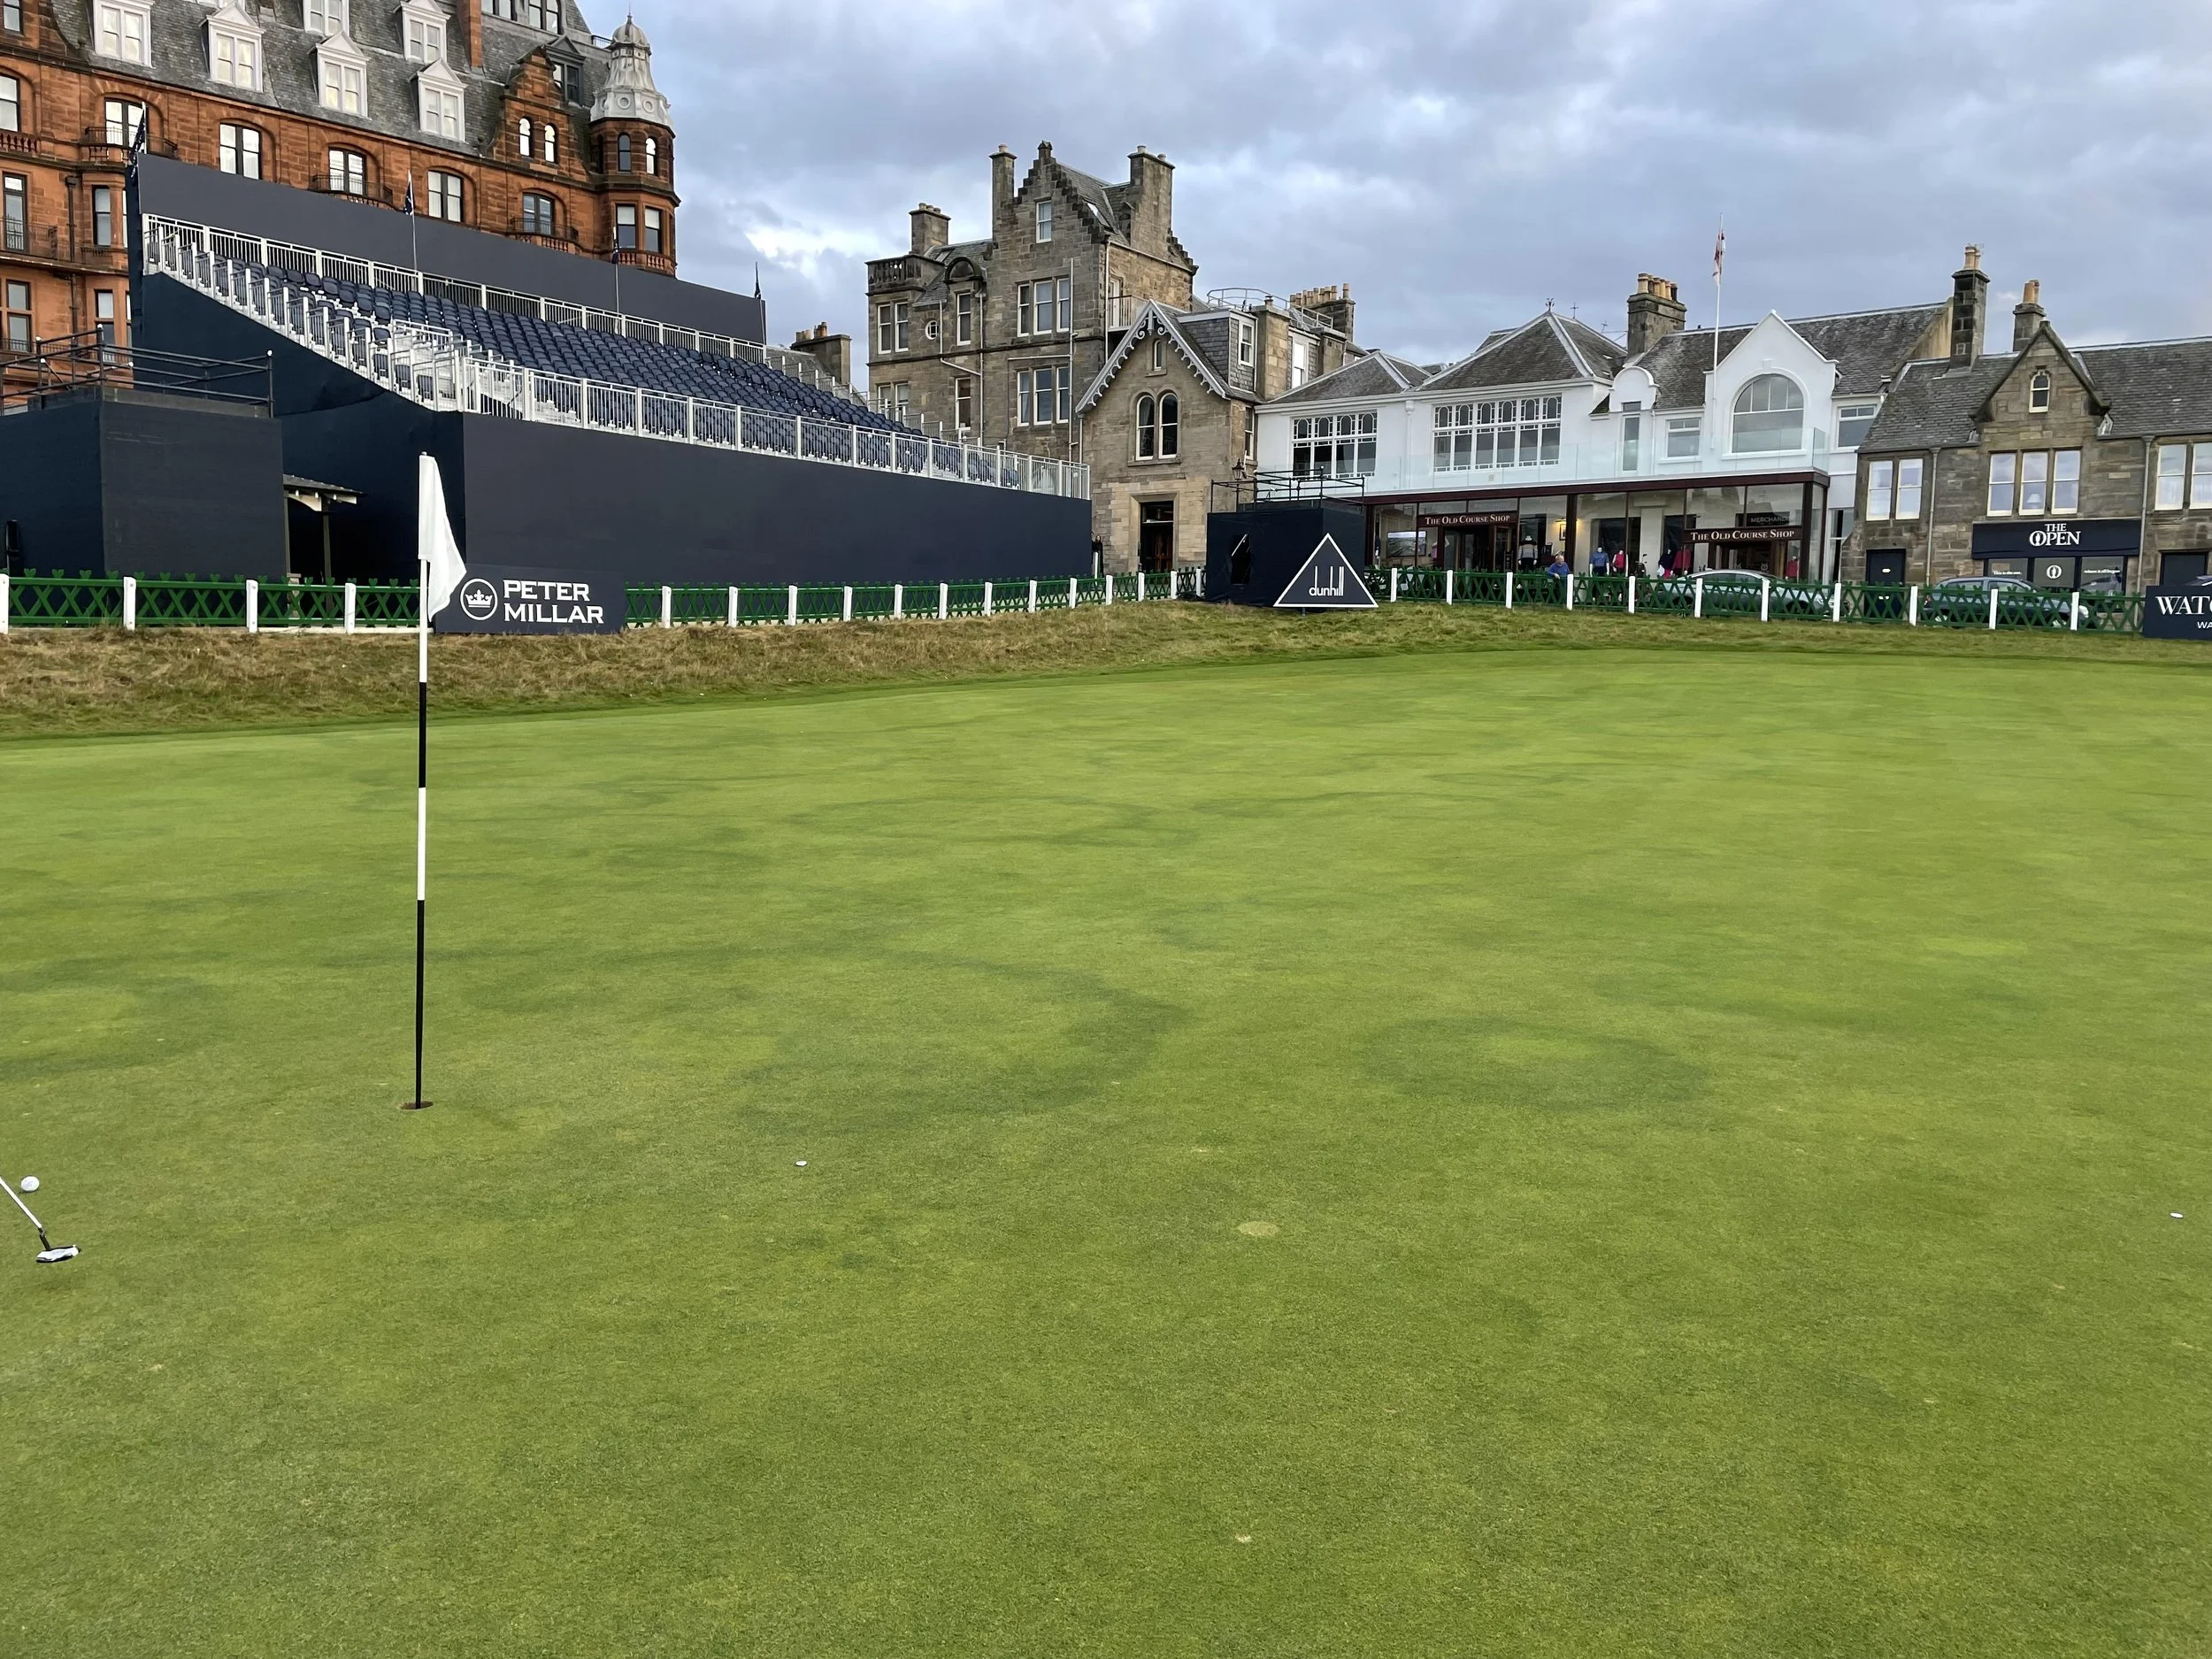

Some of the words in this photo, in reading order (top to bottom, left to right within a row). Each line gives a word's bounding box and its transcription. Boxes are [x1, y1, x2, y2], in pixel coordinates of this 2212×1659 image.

[1459, 515, 1488, 524] COURSE
[1691, 532, 1709, 541] THE
[1710, 531, 1731, 540] OLD
[1732, 530, 1769, 540] COURSE
[1770, 529, 1794, 538] SHOP
[2029, 531, 2081, 547] OPEN
[1309, 565, 1344, 596] dunhill
[503, 580, 590, 602] PETER
[503, 603, 604, 624] MILLAR
[2154, 595, 2212, 614] WAT
